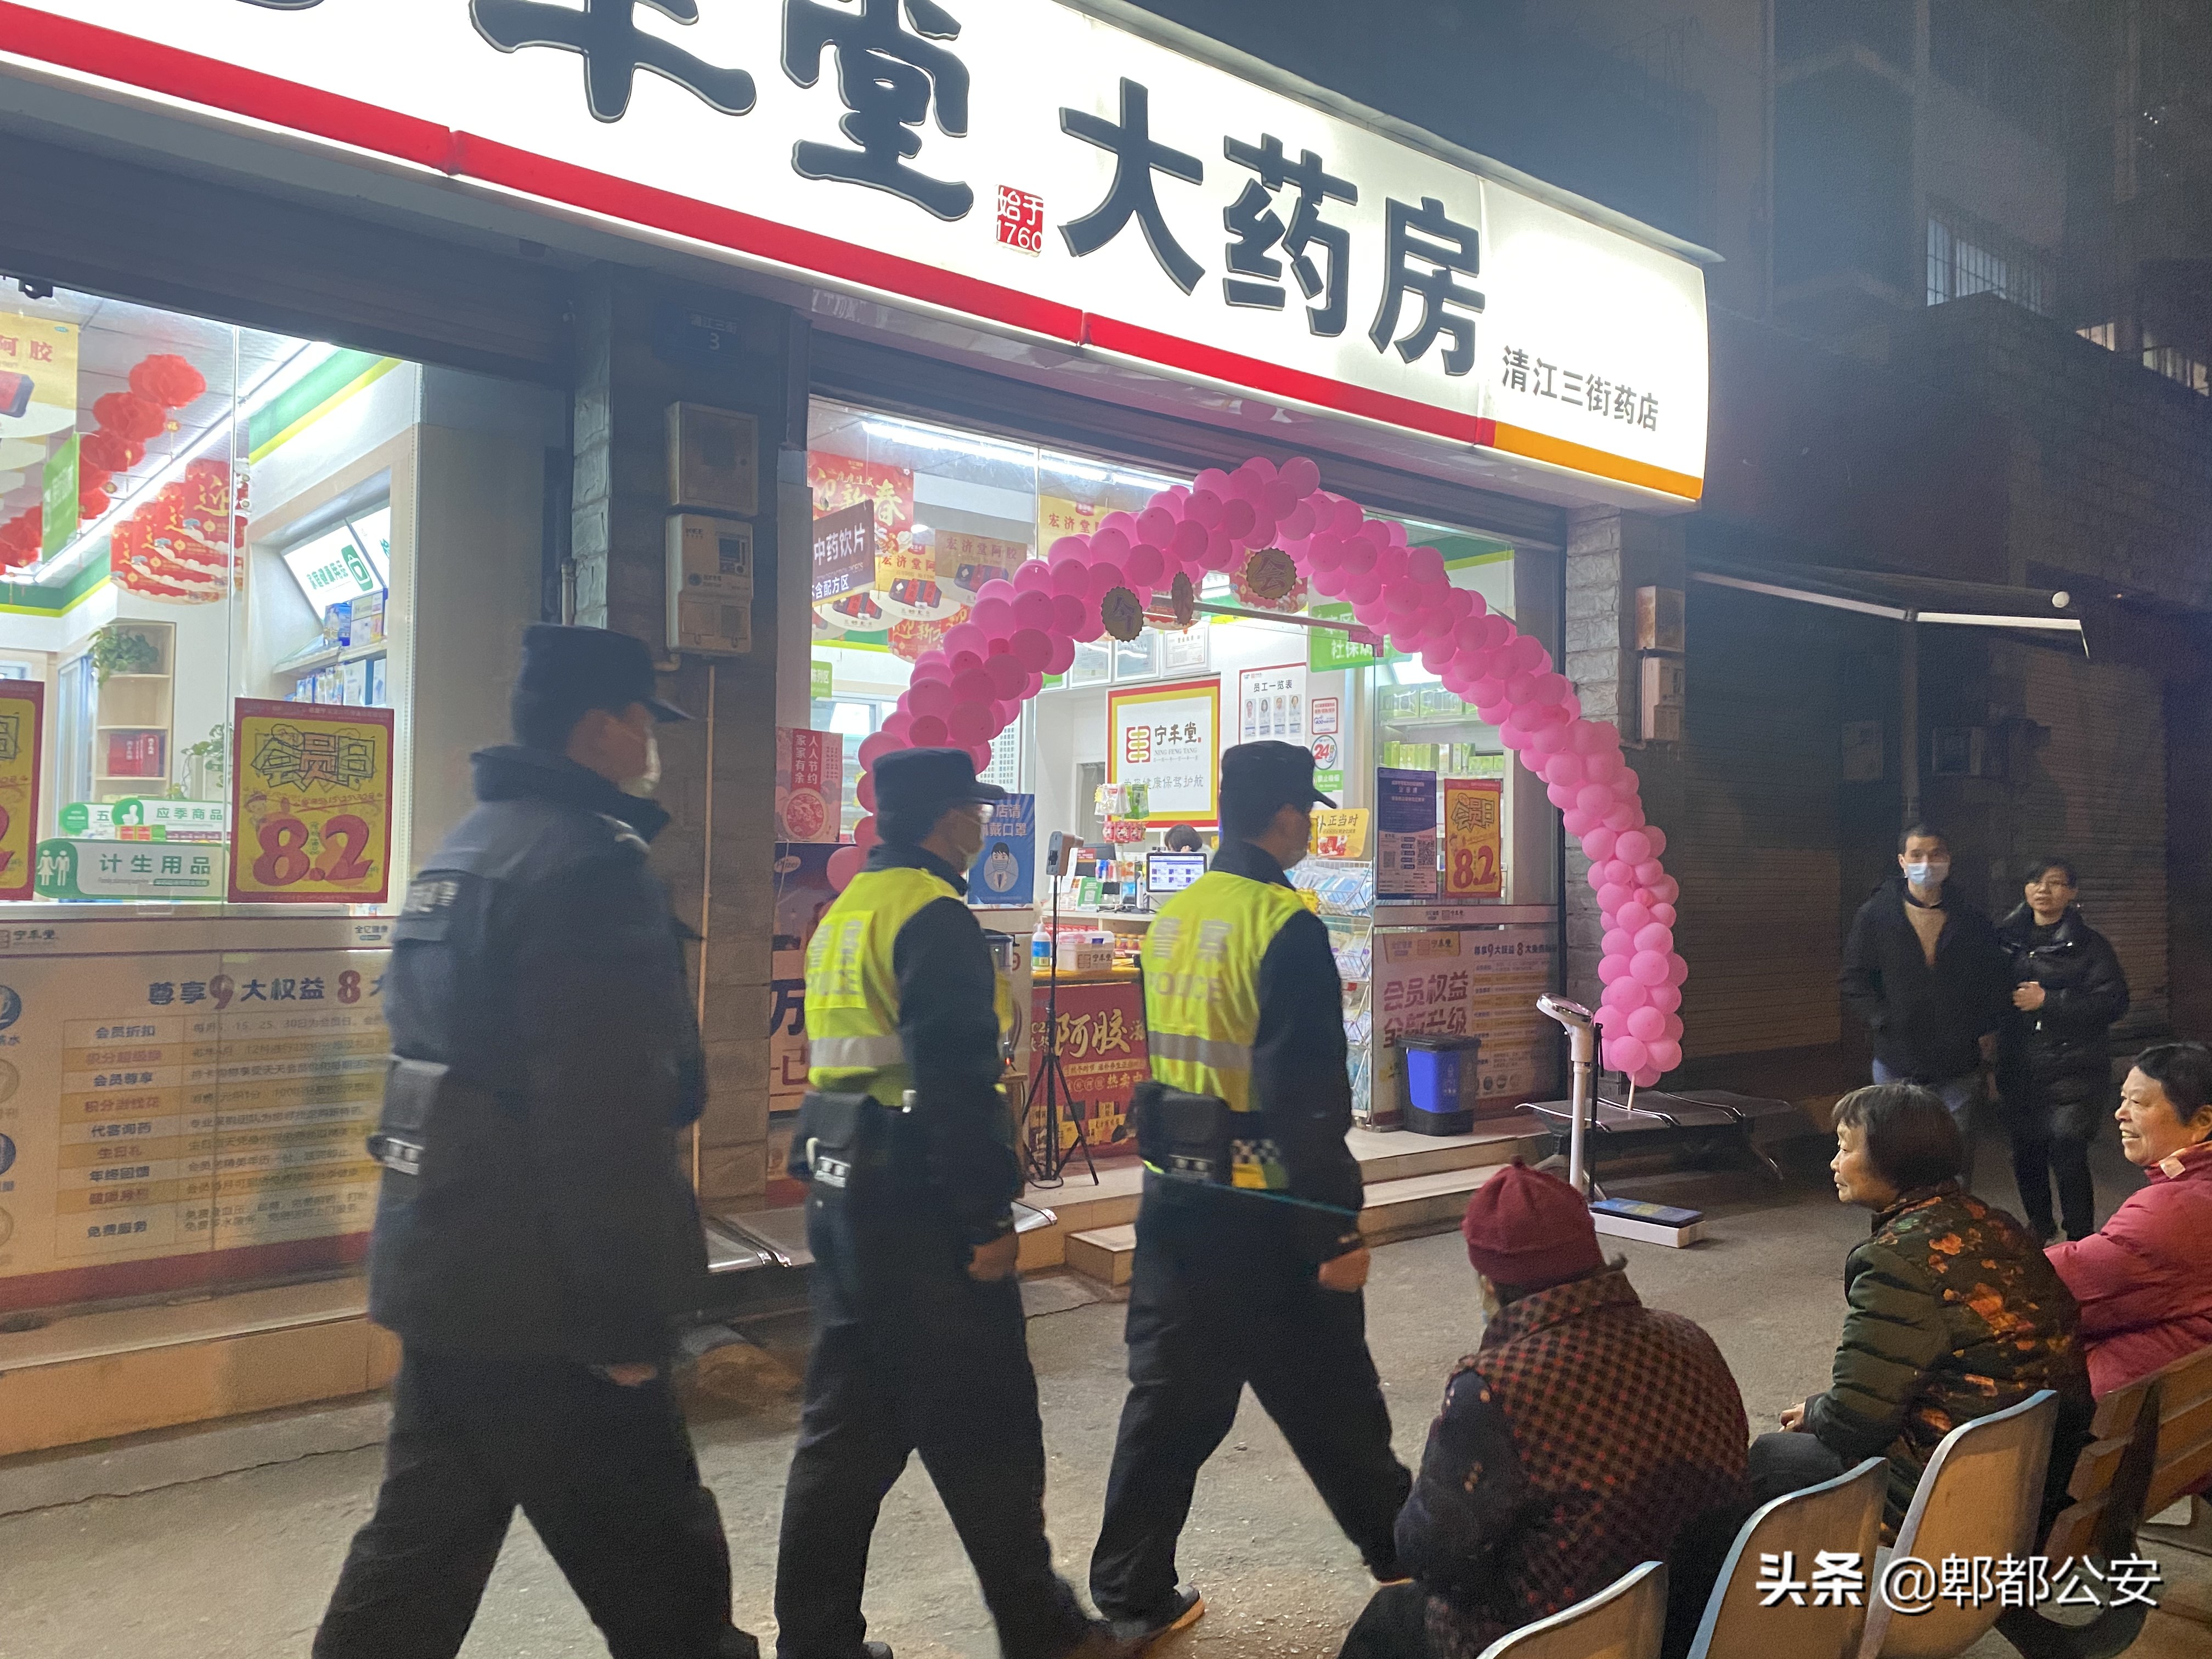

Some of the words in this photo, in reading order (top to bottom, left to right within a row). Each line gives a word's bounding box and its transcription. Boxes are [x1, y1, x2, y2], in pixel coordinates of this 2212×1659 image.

[261, 0, 974, 222] 丰堂
[997, 187, 1043, 225] 始于
[997, 219, 1042, 253] 1760
[1058, 77, 1486, 376] 大药房
[710, 332, 720, 351] 3
[1502, 345, 1658, 432] 清江三街药店
[814, 522, 866, 566] 中药饮片
[947, 537, 1017, 560] 宏济堂阿胶
[1254, 680, 1293, 692] 员工一览表
[1154, 721, 1197, 746] 宁丰堂
[1314, 744, 1329, 760] 24
[251, 730, 375, 792] 会员日
[794, 735, 806, 784] 家家有余
[807, 736, 819, 785] 人人节约
[156, 807, 223, 821] 应季商品
[994, 804, 1022, 819] 店请
[1451, 797, 1494, 832] 会员日
[99, 854, 210, 875] 计生用品
[253, 814, 374, 887] 8.2
[1454, 845, 1497, 889] 8.2
[148, 974, 325, 1010] 尊享9大权益
[1384, 970, 1468, 1012] 会员权益
[95, 1025, 156, 1039] 会员折扣
[1055, 1008, 1131, 1058] 阿胶
